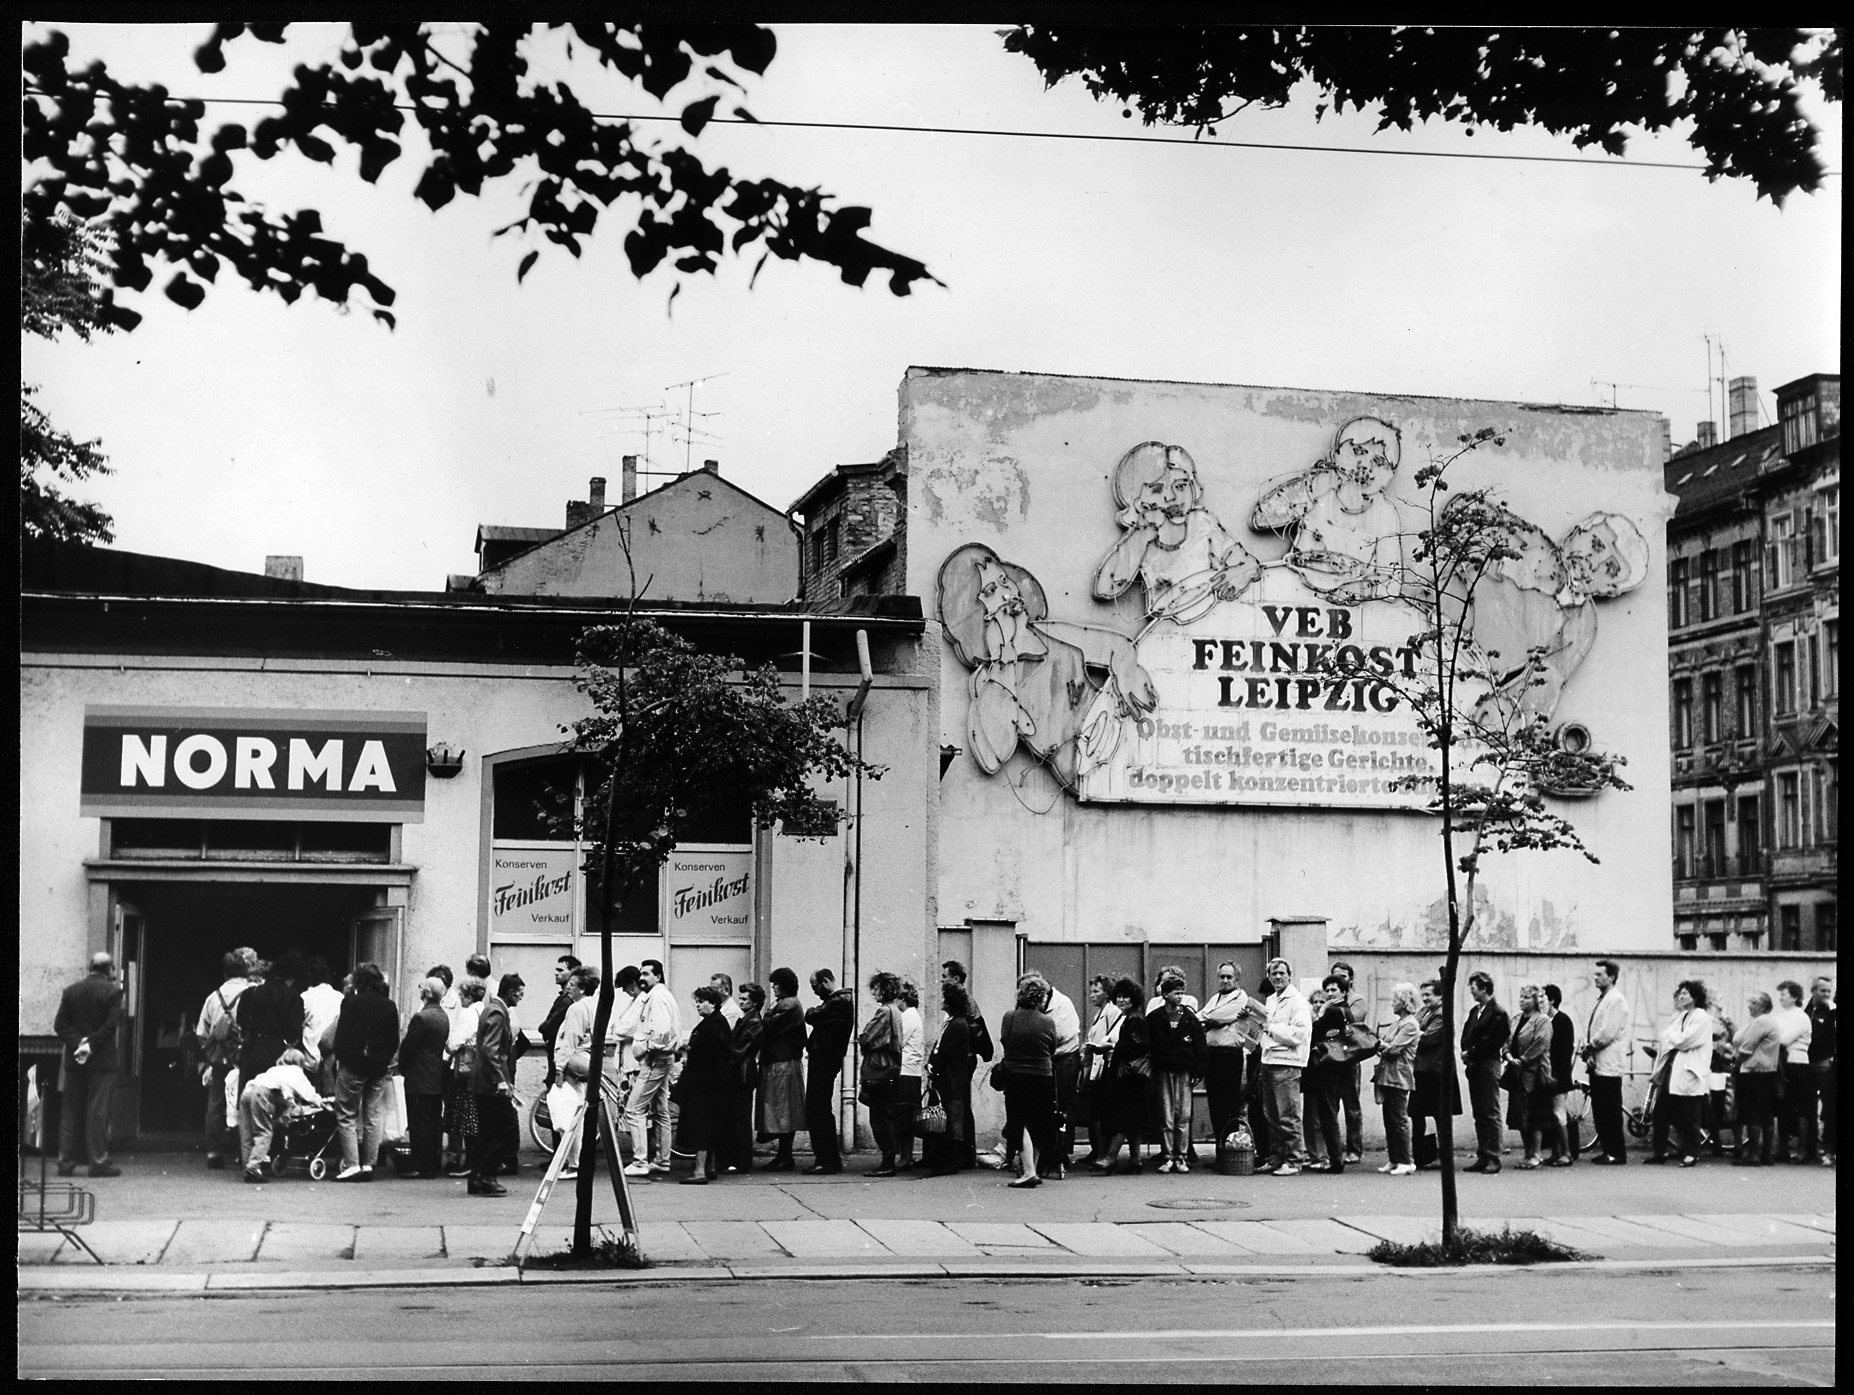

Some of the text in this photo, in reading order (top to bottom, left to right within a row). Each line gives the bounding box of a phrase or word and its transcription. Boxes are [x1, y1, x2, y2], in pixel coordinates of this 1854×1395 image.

[1261, 605, 1353, 640] VEB
[1192, 638, 1422, 680] FEINKOST
[1217, 676, 1400, 713] LEIPZIG
[1136, 717, 1199, 740] Obst-
[1203, 721, 1250, 742] und
[120, 734, 397, 792] NORMA
[1183, 745, 1323, 772] tischfertige
[1128, 767, 1222, 794] doppelt
[495, 859, 548, 869] Konserven
[674, 862, 726, 872] Konserven
[494, 870, 572, 917] Feinkost
[674, 872, 750, 919] Feinkost
[531, 913, 570, 923] Verkauf
[711, 914, 749, 924] Verkauf
